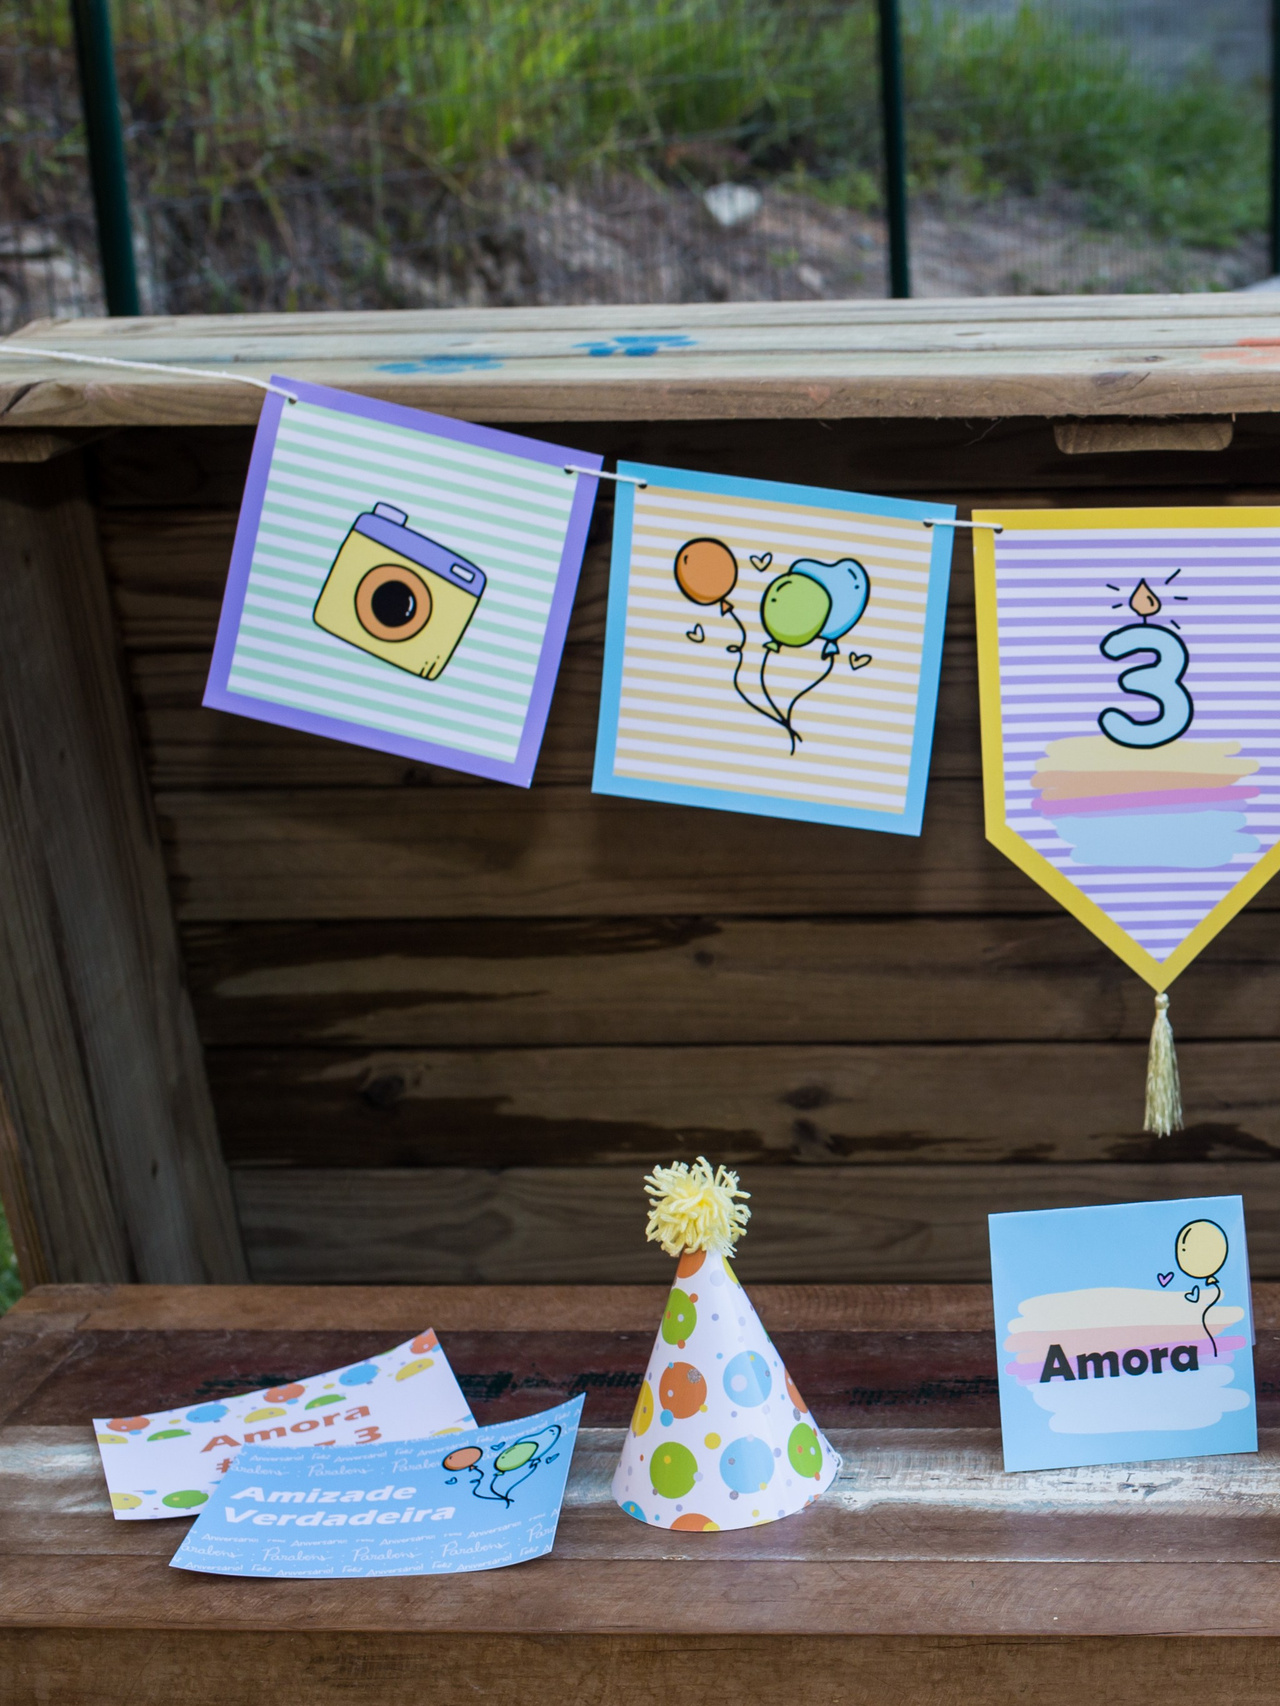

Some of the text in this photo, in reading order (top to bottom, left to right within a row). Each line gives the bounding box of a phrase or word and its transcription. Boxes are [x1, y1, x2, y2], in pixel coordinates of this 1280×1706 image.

[1097, 622, 1194, 749] 3
[1039, 1344, 1199, 1383] Amora
[200, 1405, 370, 1453] Amora
[231, 1485, 416, 1503] Amizade
[224, 1506, 456, 1527] Verdadeira
